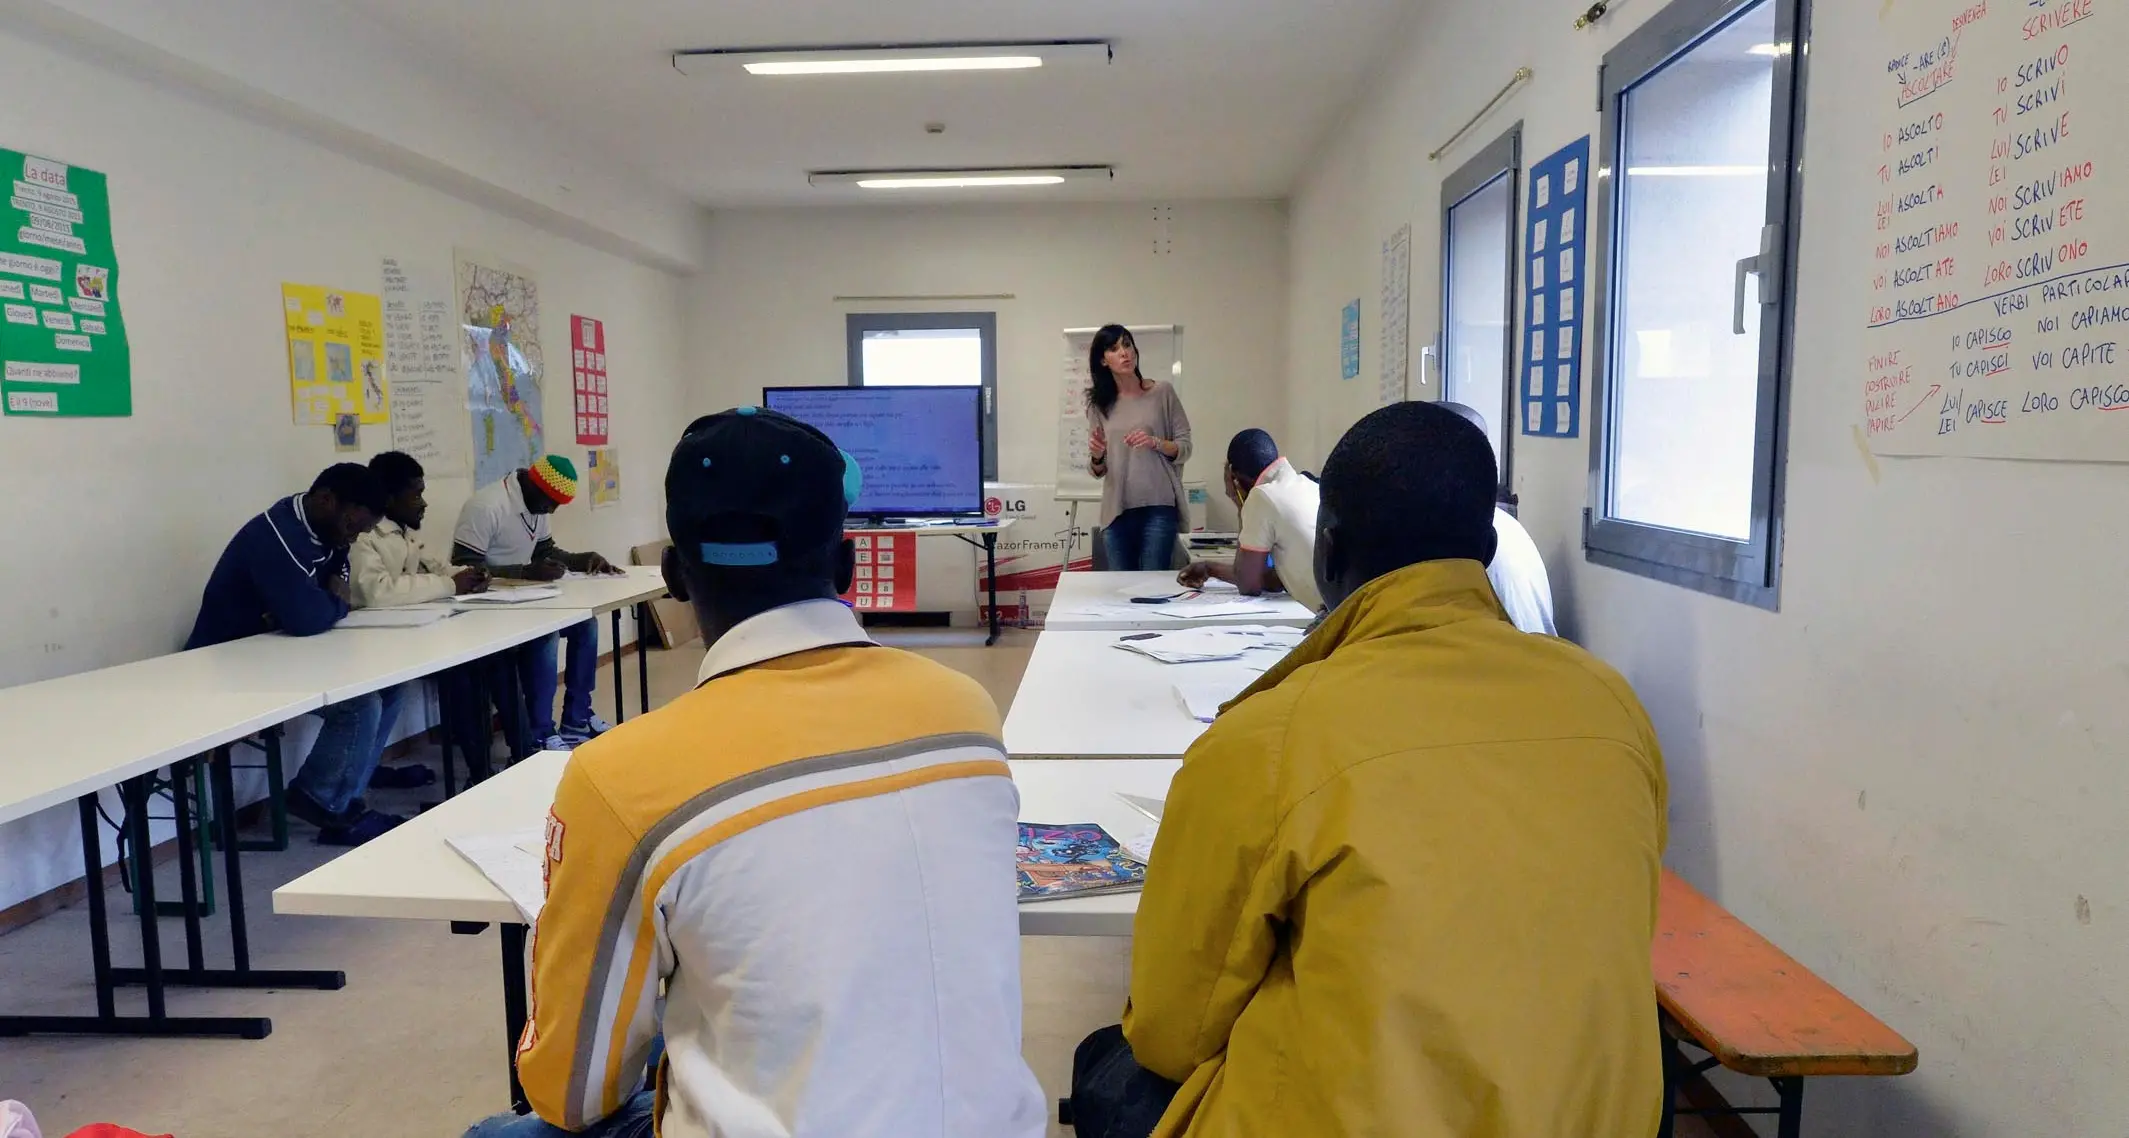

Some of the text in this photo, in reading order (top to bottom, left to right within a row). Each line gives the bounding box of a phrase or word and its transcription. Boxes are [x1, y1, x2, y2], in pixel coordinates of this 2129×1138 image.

[2022, 0, 2092, 40] SCRIVERE
[1997, 44, 2069, 94] IO SCRIVO
[1993, 101, 2008, 126] TU
[1898, 112, 1943, 144] ASCOLTO
[2014, 111, 2070, 159] SCRIVE
[25, 163, 66, 186] La data
[1878, 164, 1892, 184] TU
[1898, 185, 1944, 212] ASCOLTA
[1989, 194, 2008, 214] NOI
[1876, 243, 1890, 258] NOI
[1984, 261, 2012, 287] LORO
[1870, 306, 1891, 323] LORO
[1993, 294, 2028, 317] VERBI
[2038, 316, 2058, 333] NOI
[56, 336, 90, 346] Domenica
[1952, 327, 2012, 352] IO CAPISCO
[1950, 353, 2009, 379] TU CAPISCI
[2032, 343, 2116, 370] VOI CAPITE
[7, 366, 31, 377] Quanti
[1966, 400, 2008, 423] CAPISCE
[2021, 391, 2059, 413] LORO
[1938, 418, 1957, 435] LEI
[1006, 500, 1026, 512] LG
[996, 539, 1076, 550] azorFrameTV
